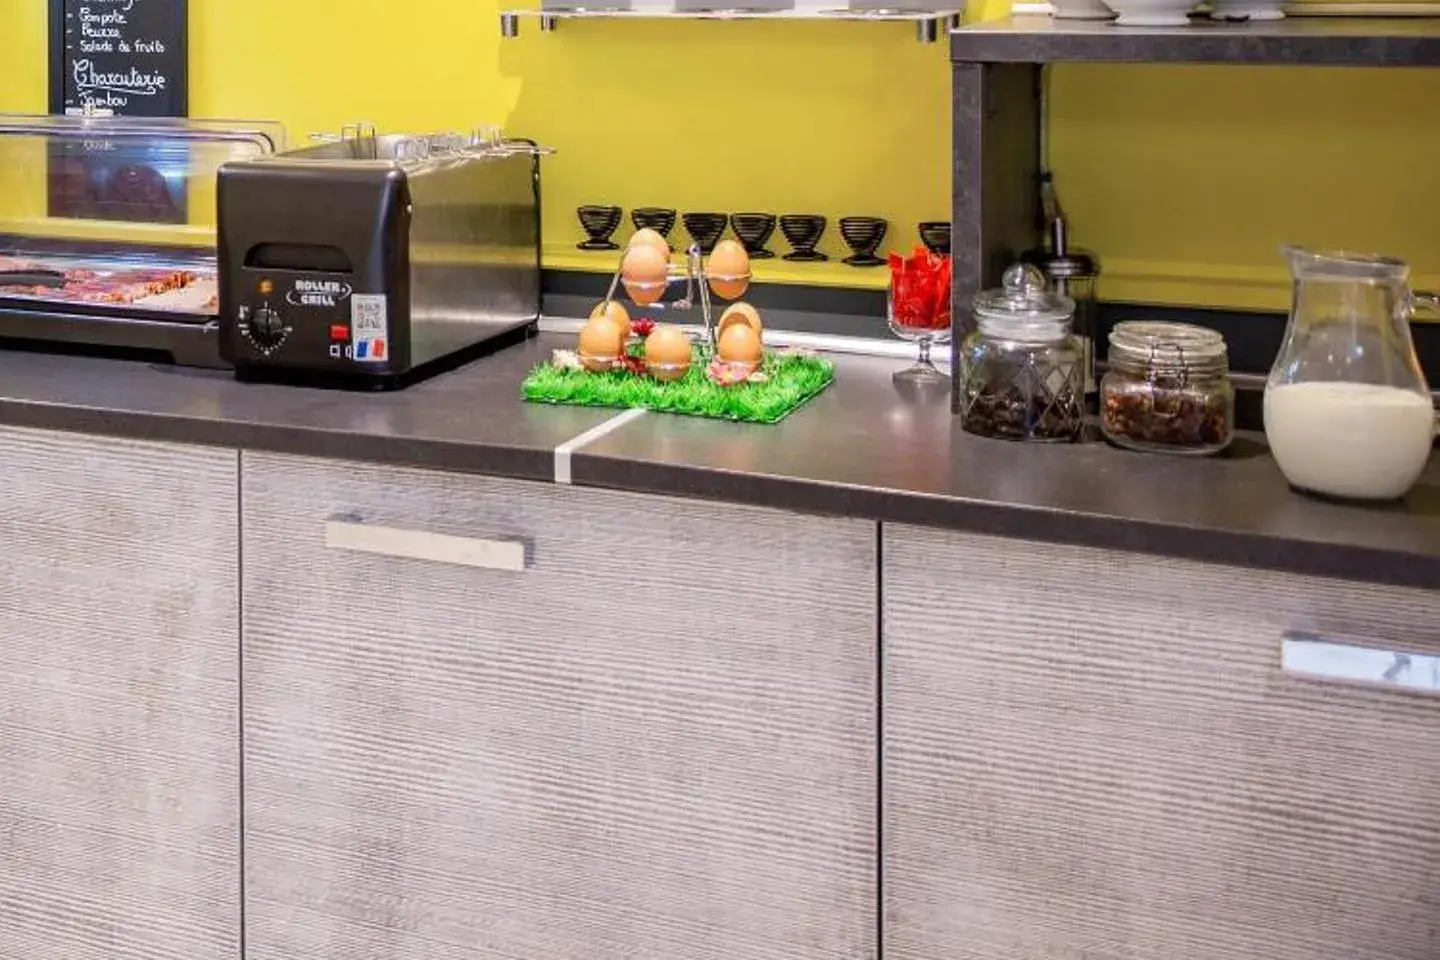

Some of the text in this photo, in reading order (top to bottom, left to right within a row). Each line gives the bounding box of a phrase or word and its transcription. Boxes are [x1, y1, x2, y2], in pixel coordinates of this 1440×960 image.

[80, 39, 166, 53] Salade de fruits
[295, 279, 341, 292] ROLLER
[301, 294, 336, 307] GRILL
